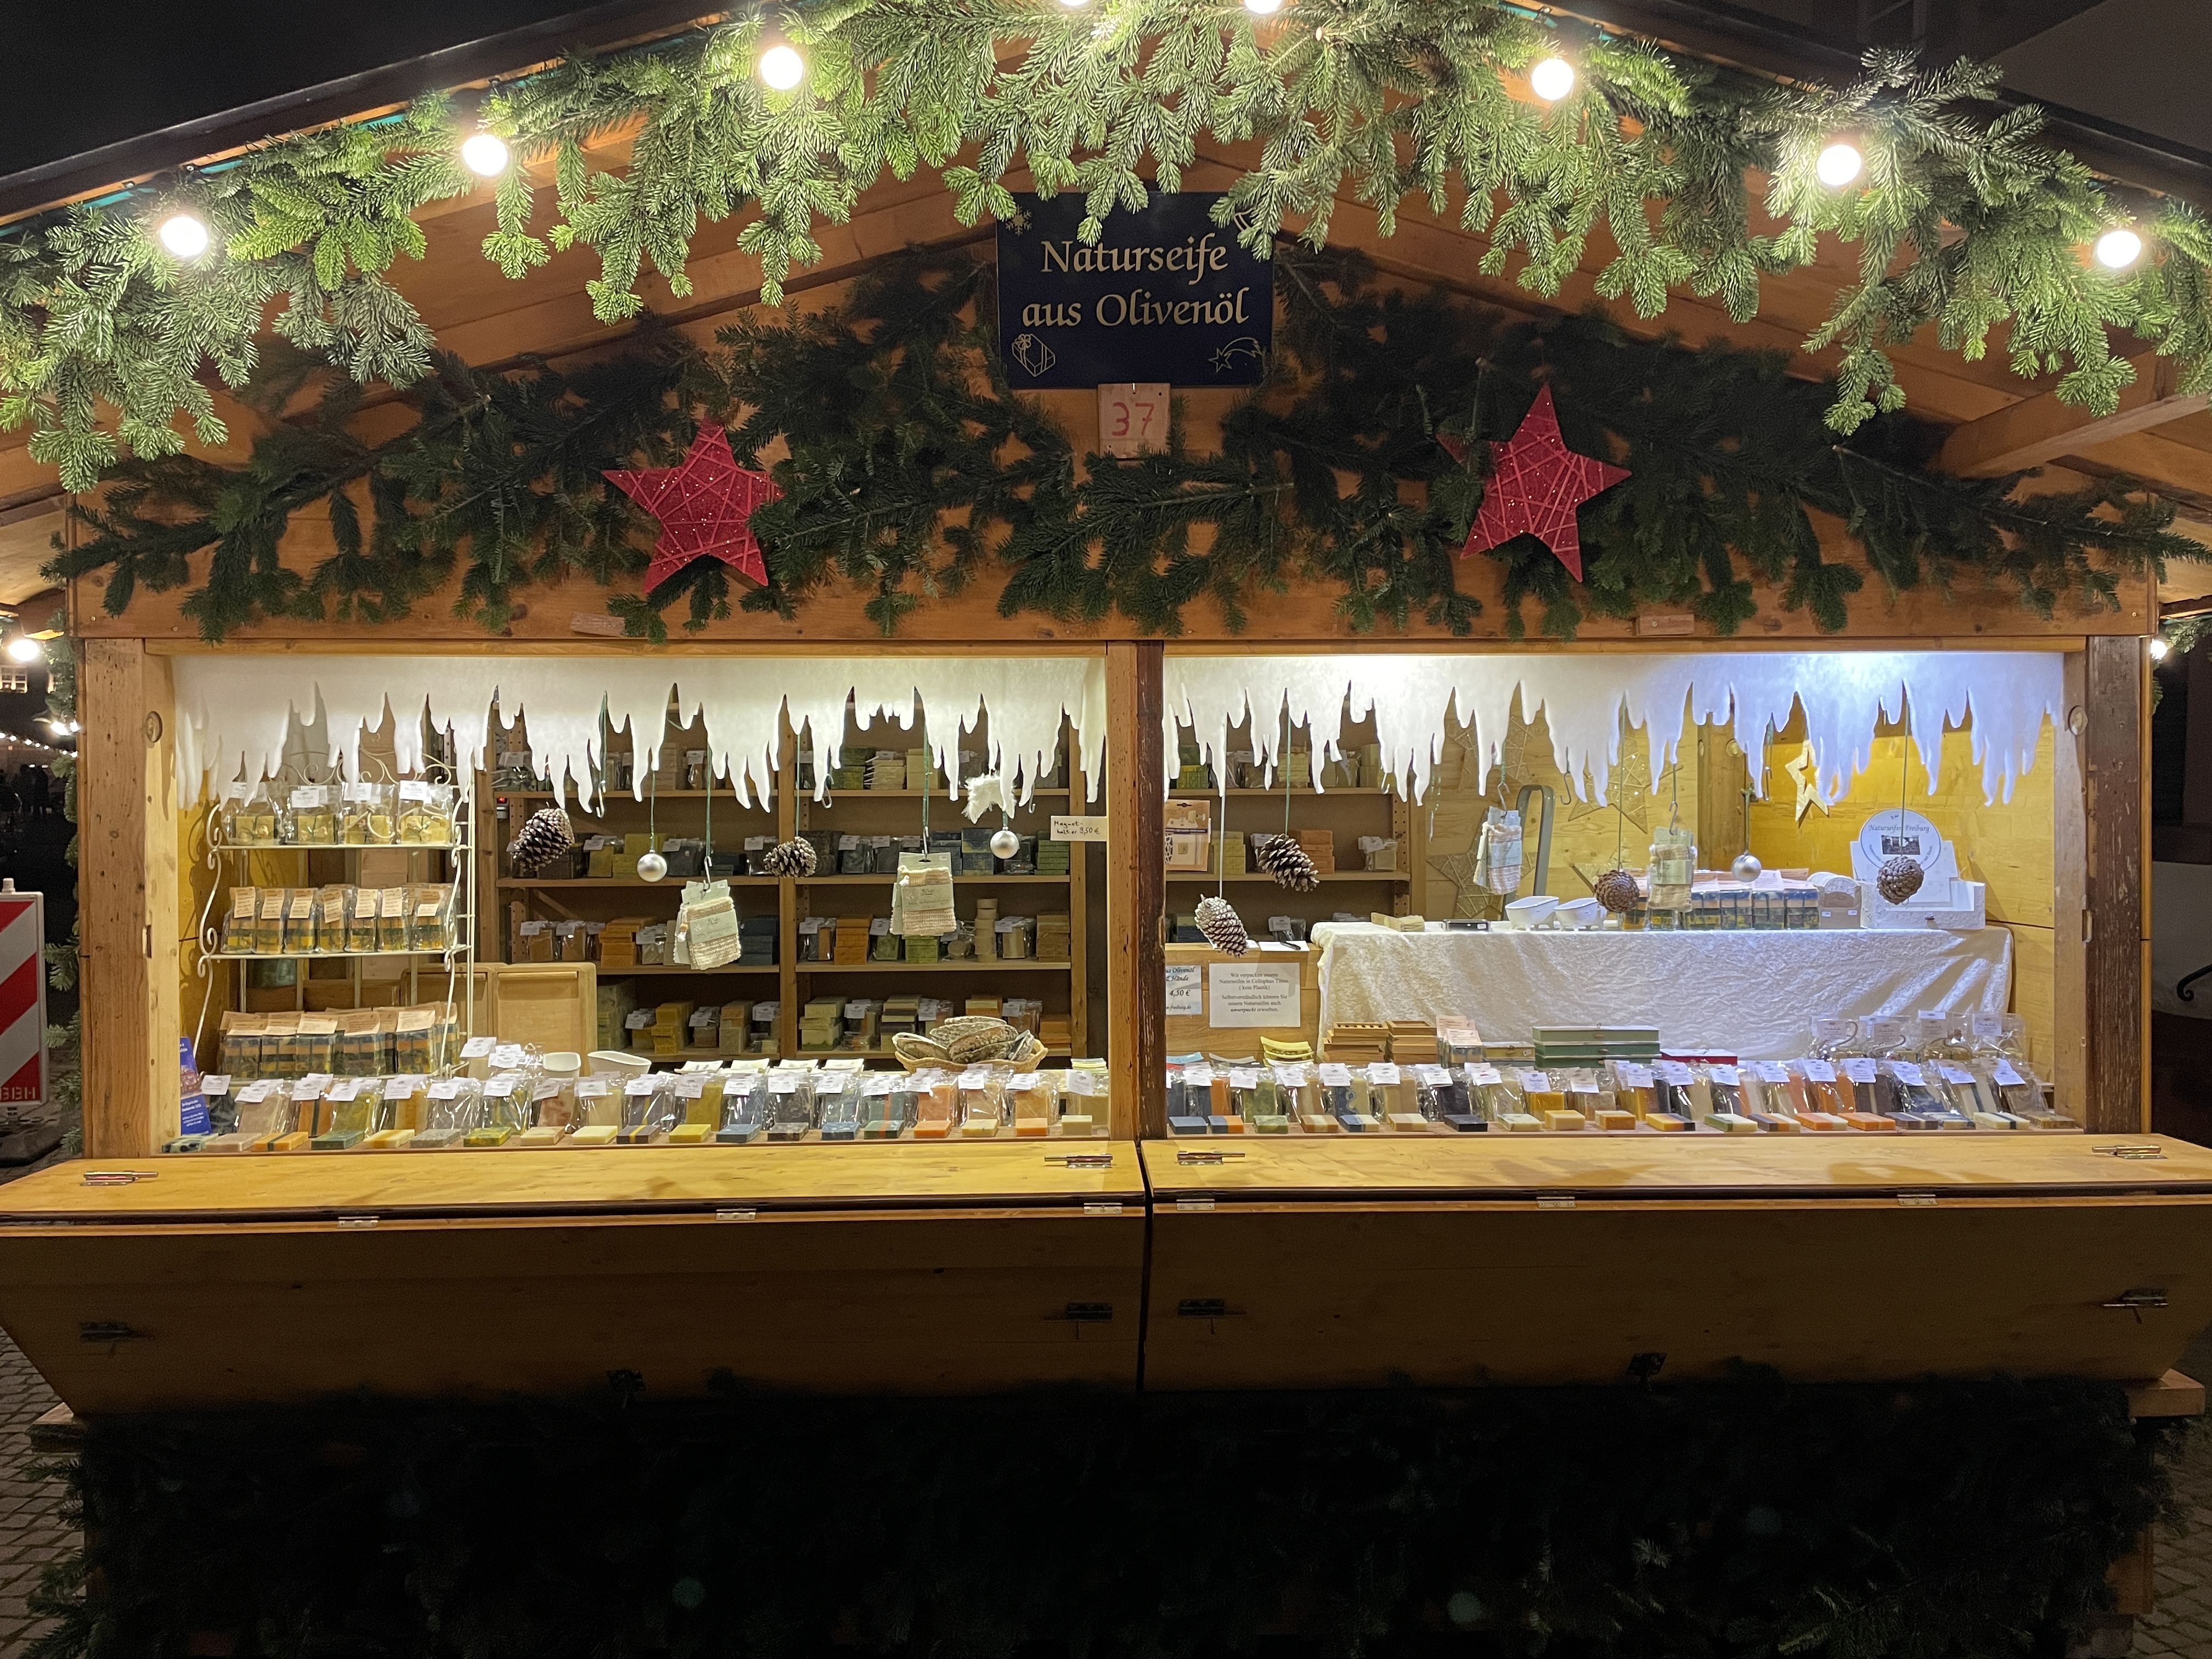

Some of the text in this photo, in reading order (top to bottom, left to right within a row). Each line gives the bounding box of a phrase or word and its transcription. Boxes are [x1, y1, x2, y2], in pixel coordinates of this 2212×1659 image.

[1041, 232, 1228, 285] Naturseife
[1022, 287, 1250, 328] aus Olivenöl
[1111, 402, 1155, 437] 37
[1905, 825, 1929, 833] Freiburg
